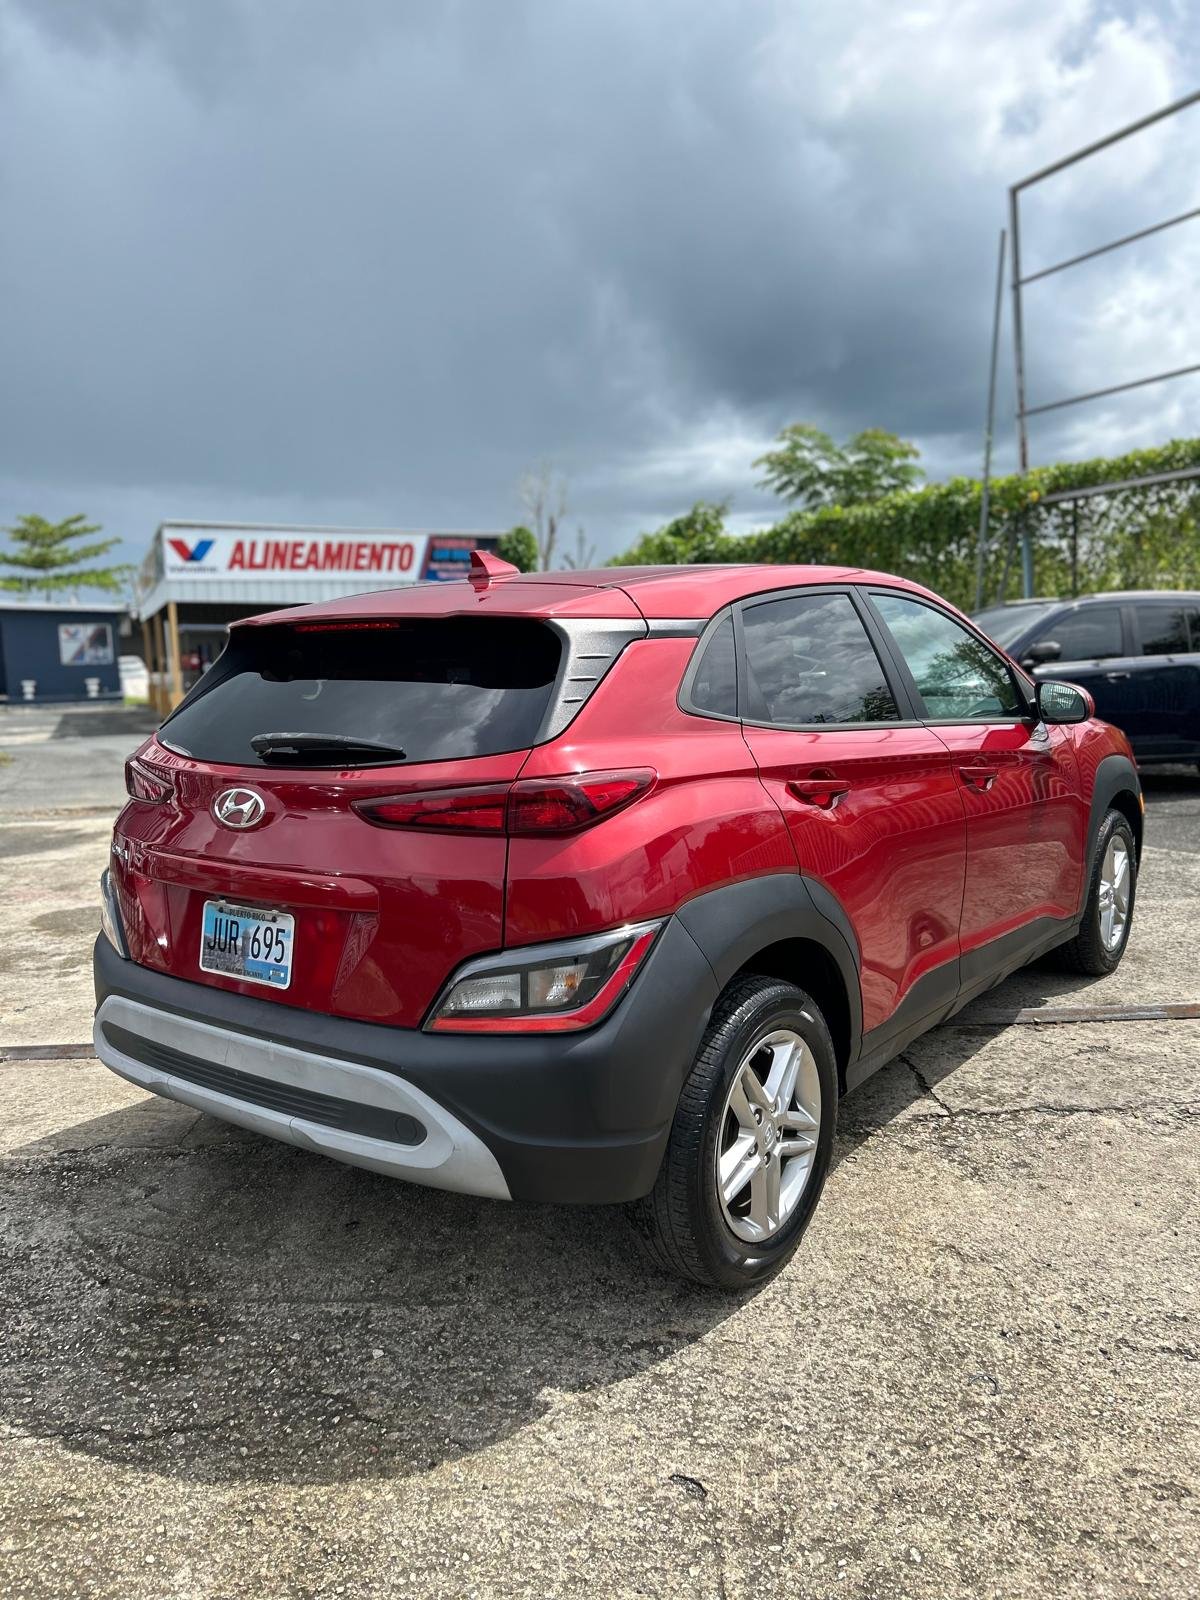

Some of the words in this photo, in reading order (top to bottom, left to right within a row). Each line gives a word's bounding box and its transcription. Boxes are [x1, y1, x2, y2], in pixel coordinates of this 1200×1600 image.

[228, 540, 414, 571] ALINEAMIENTO
[229, 908, 250, 919] PUERTO
[207, 918, 239, 955] JUR
[251, 925, 285, 963] 695
